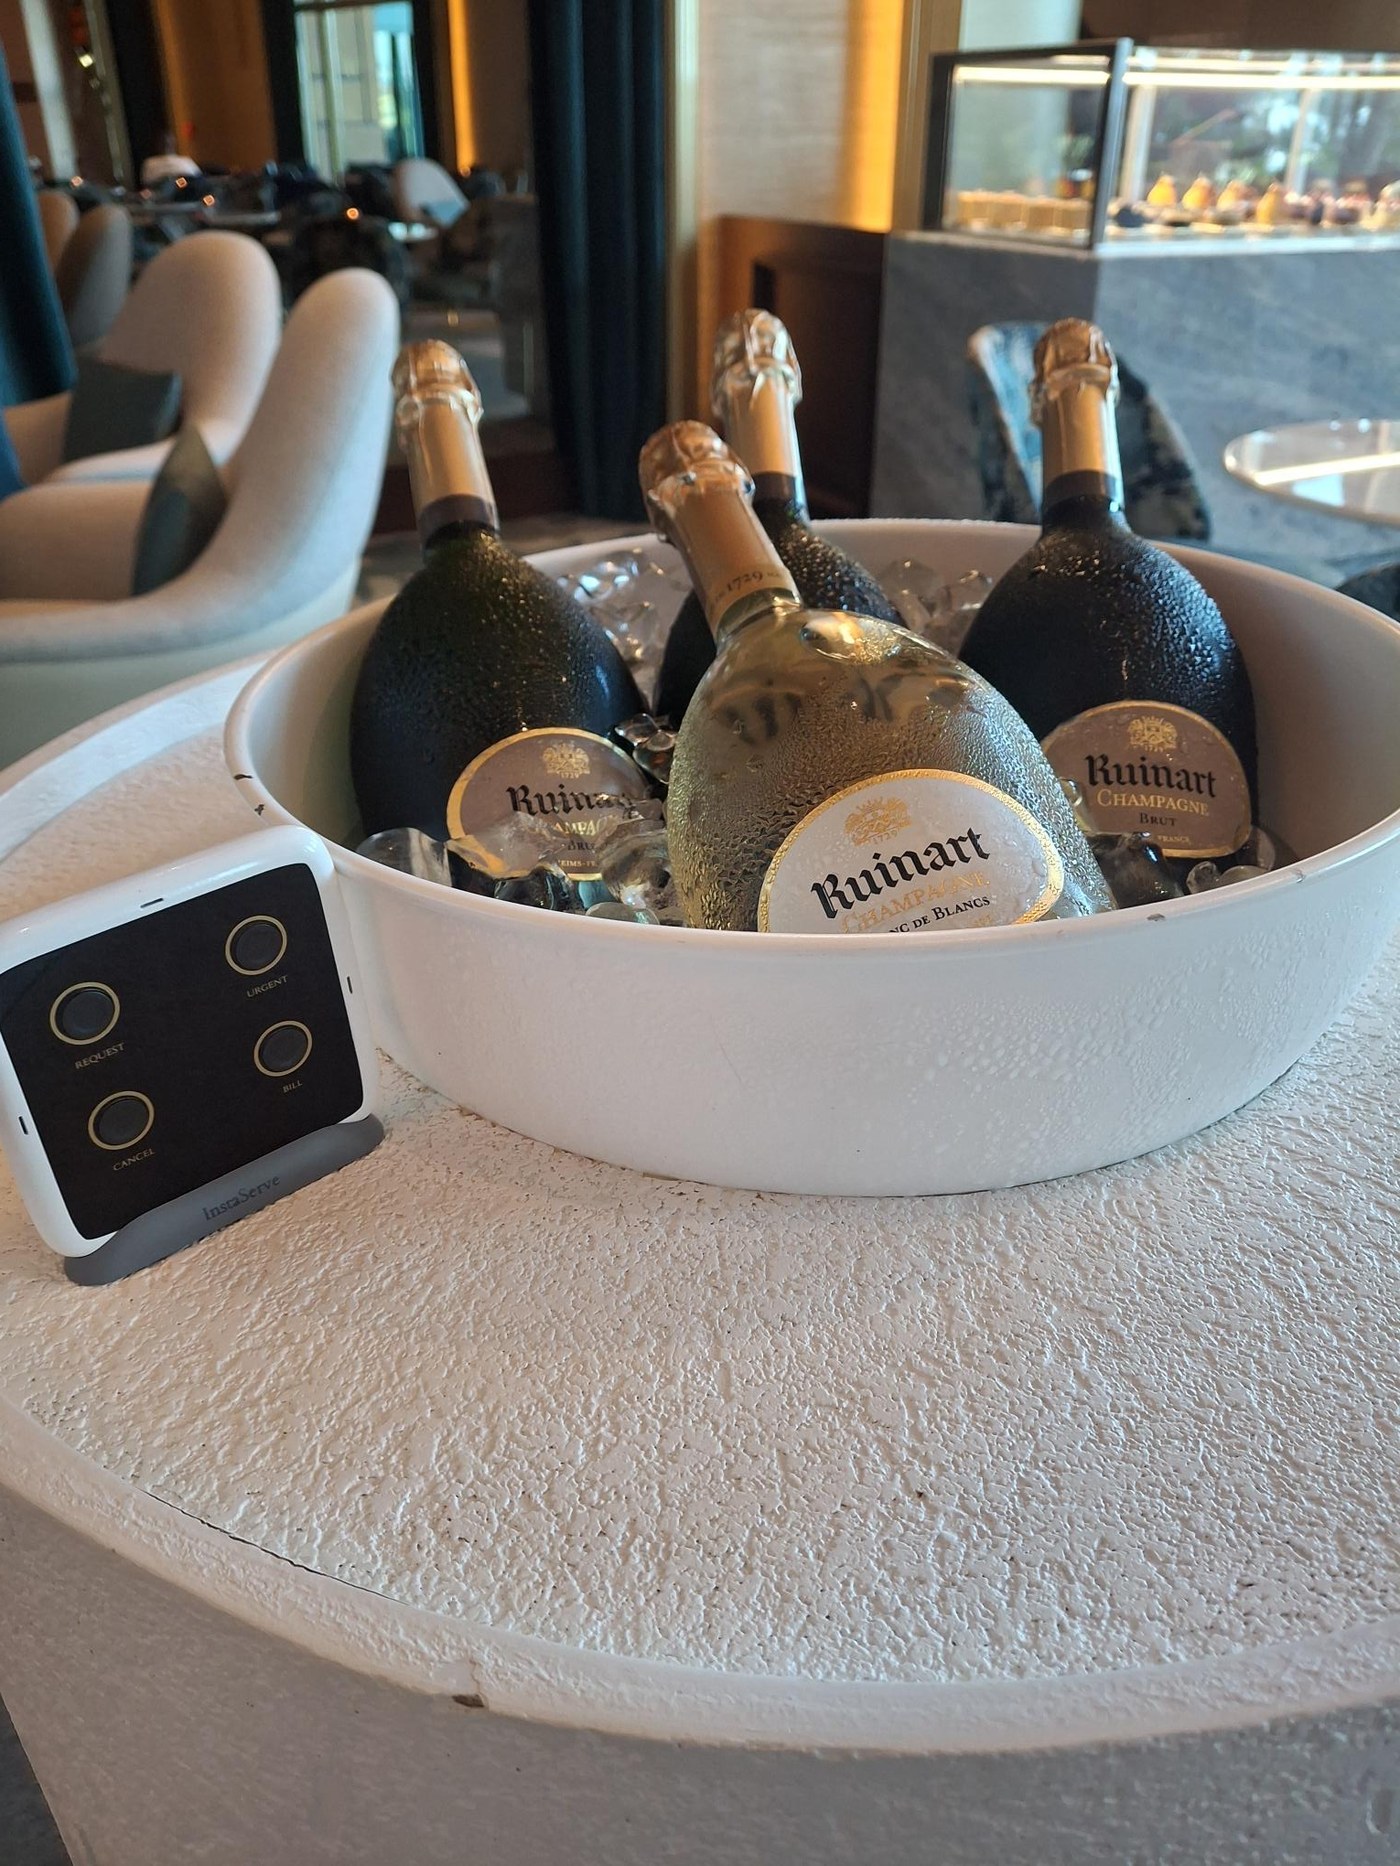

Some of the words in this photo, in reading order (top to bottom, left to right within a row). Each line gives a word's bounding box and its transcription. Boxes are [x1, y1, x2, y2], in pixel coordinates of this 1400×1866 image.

[727, 571, 763, 591] 1729
[1084, 754, 1216, 798] Ruinart
[1096, 789, 1210, 816] CHAMPAGNE
[1139, 812, 1177, 827] BRUT
[810, 828, 990, 919] Ruinart
[912, 915, 931, 929] DE
[932, 896, 991, 921] BLANCS
[246, 975, 288, 998] URGENT
[74, 1042, 125, 1069] REQUEST
[282, 1079, 303, 1094] BILL
[113, 1148, 156, 1171] CANCEL
[202, 1176, 280, 1221] InstaServe
